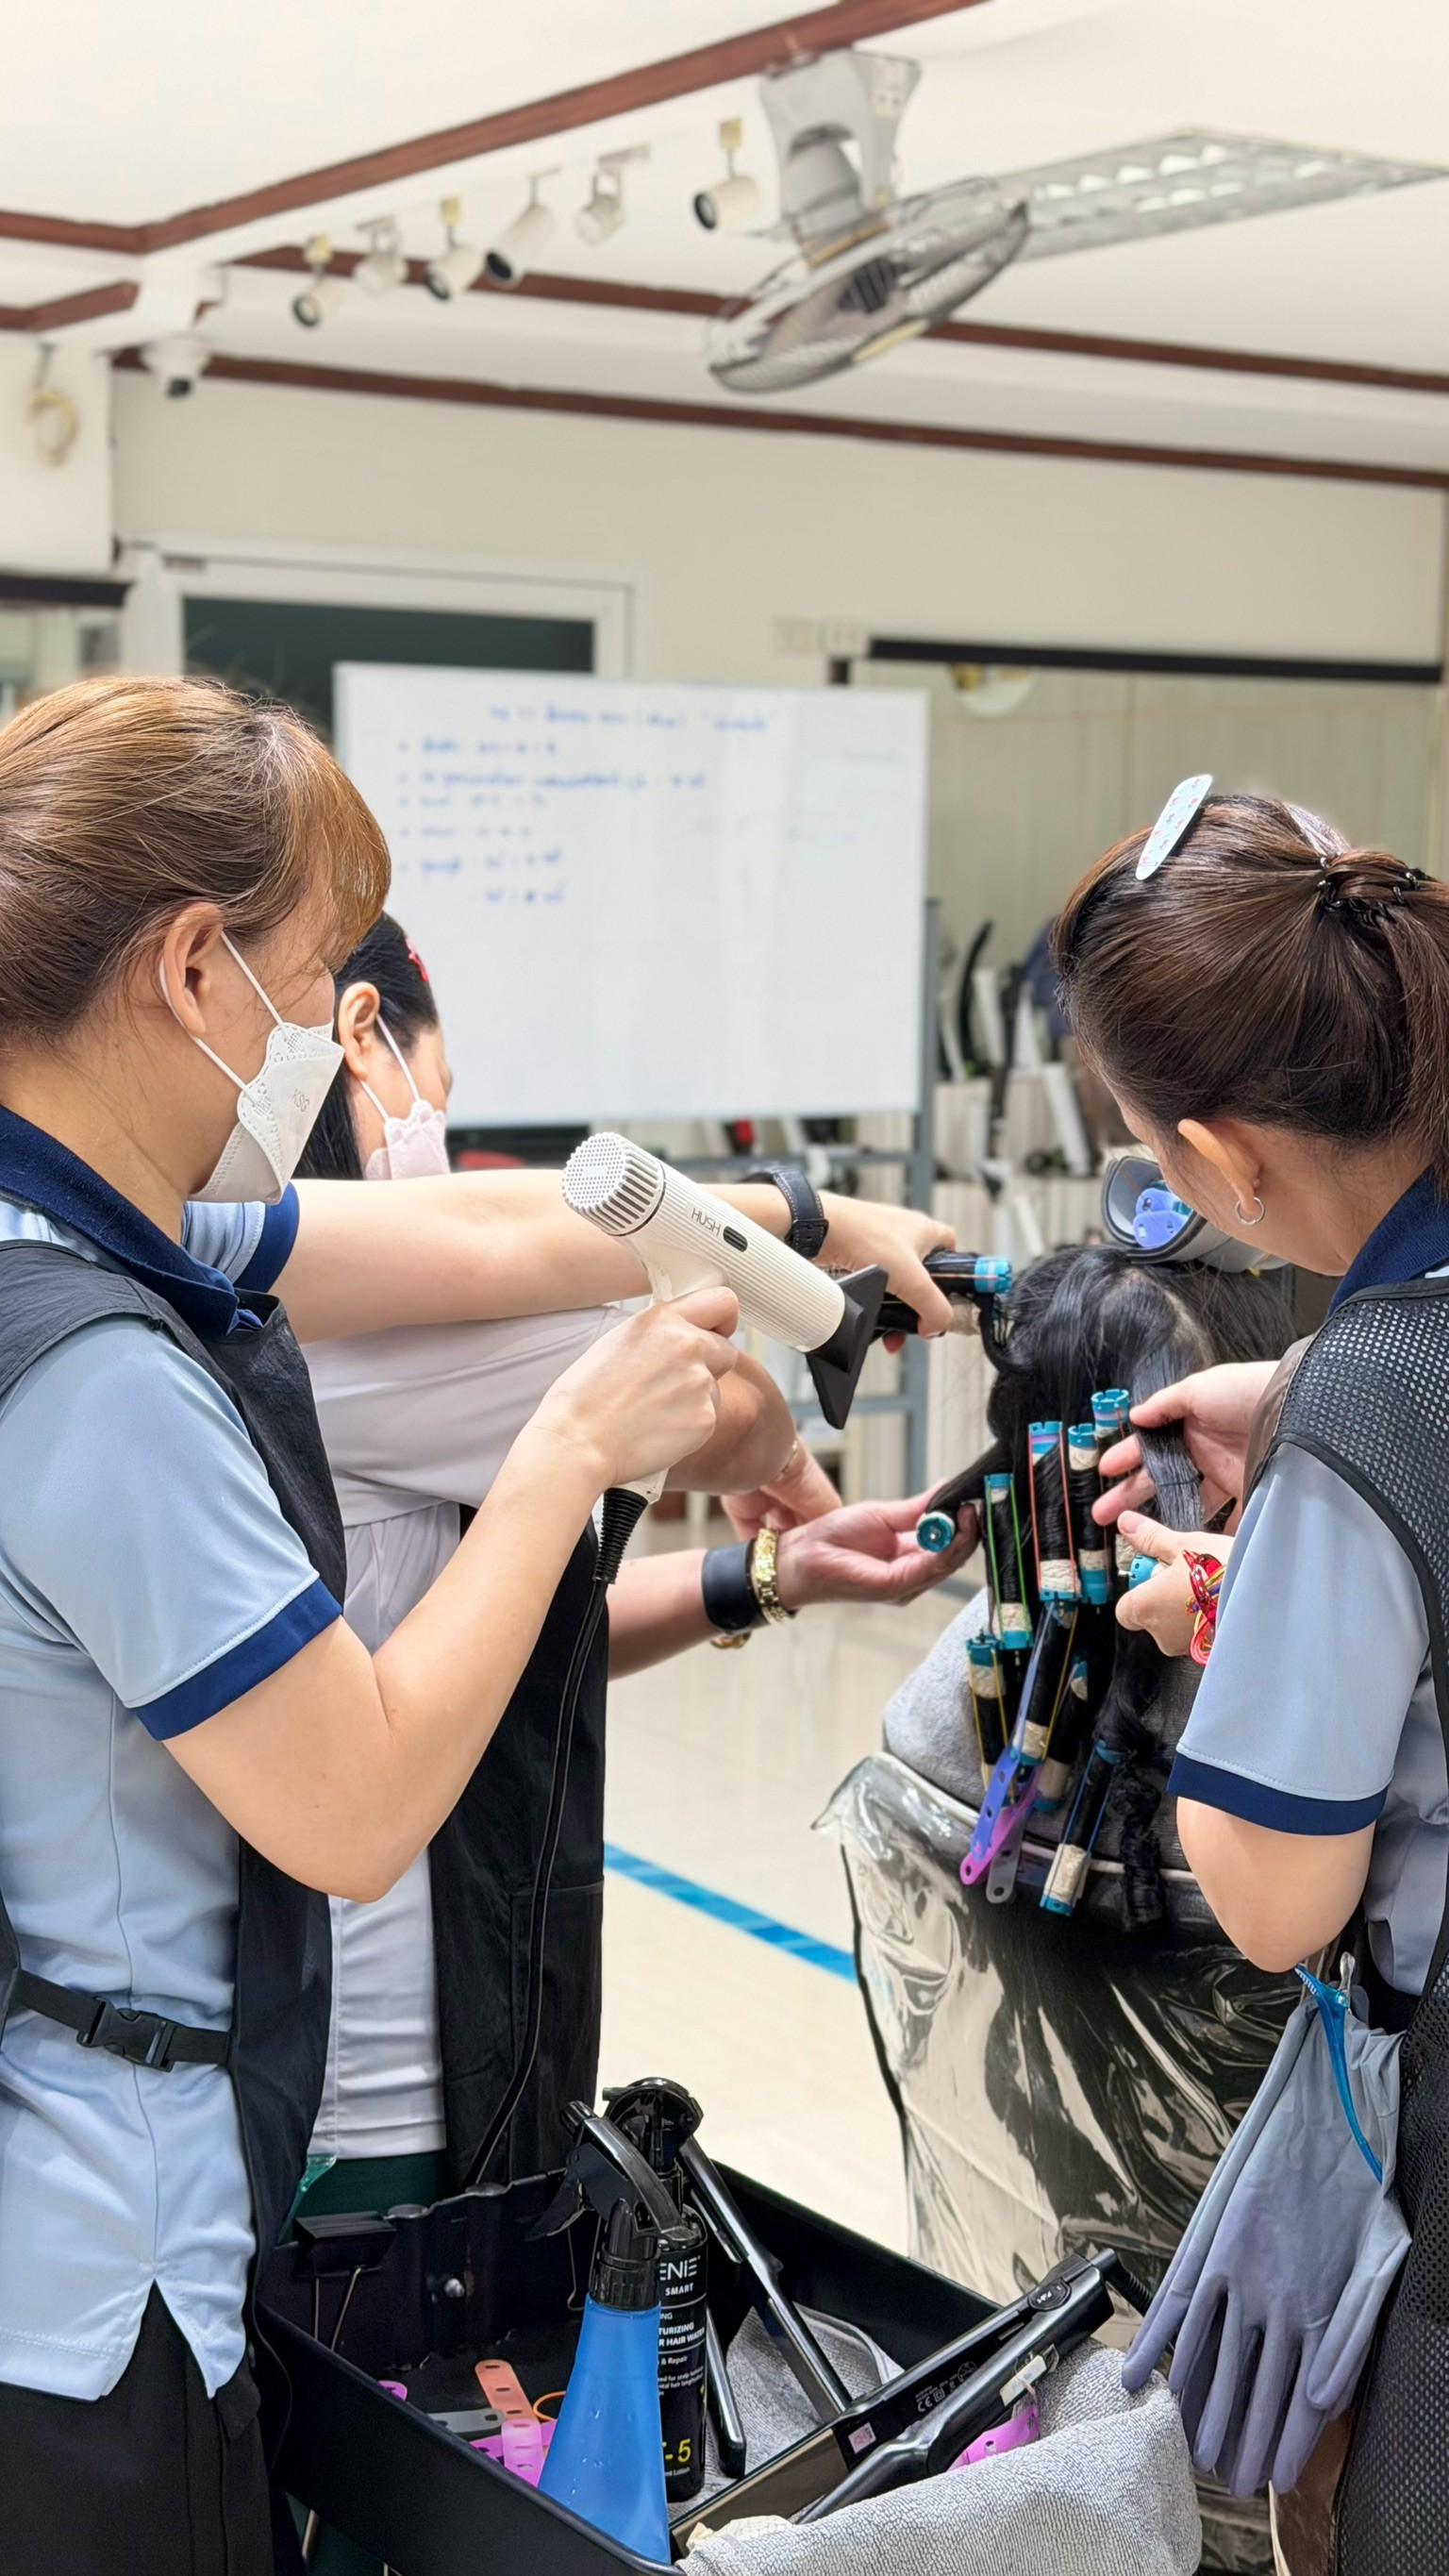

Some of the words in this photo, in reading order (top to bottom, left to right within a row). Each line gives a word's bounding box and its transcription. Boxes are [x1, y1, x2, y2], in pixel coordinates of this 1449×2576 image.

[691, 1207, 721, 1236] HUSH
[665, 2282, 694, 2296] SMART
[659, 2312, 673, 2320] NG
[658, 2322, 694, 2335] TURIZING
[666, 2335, 686, 2347] HAIR
[668, 2355, 688, 2365] Repair
[662, 2438, 691, 2463] -5
